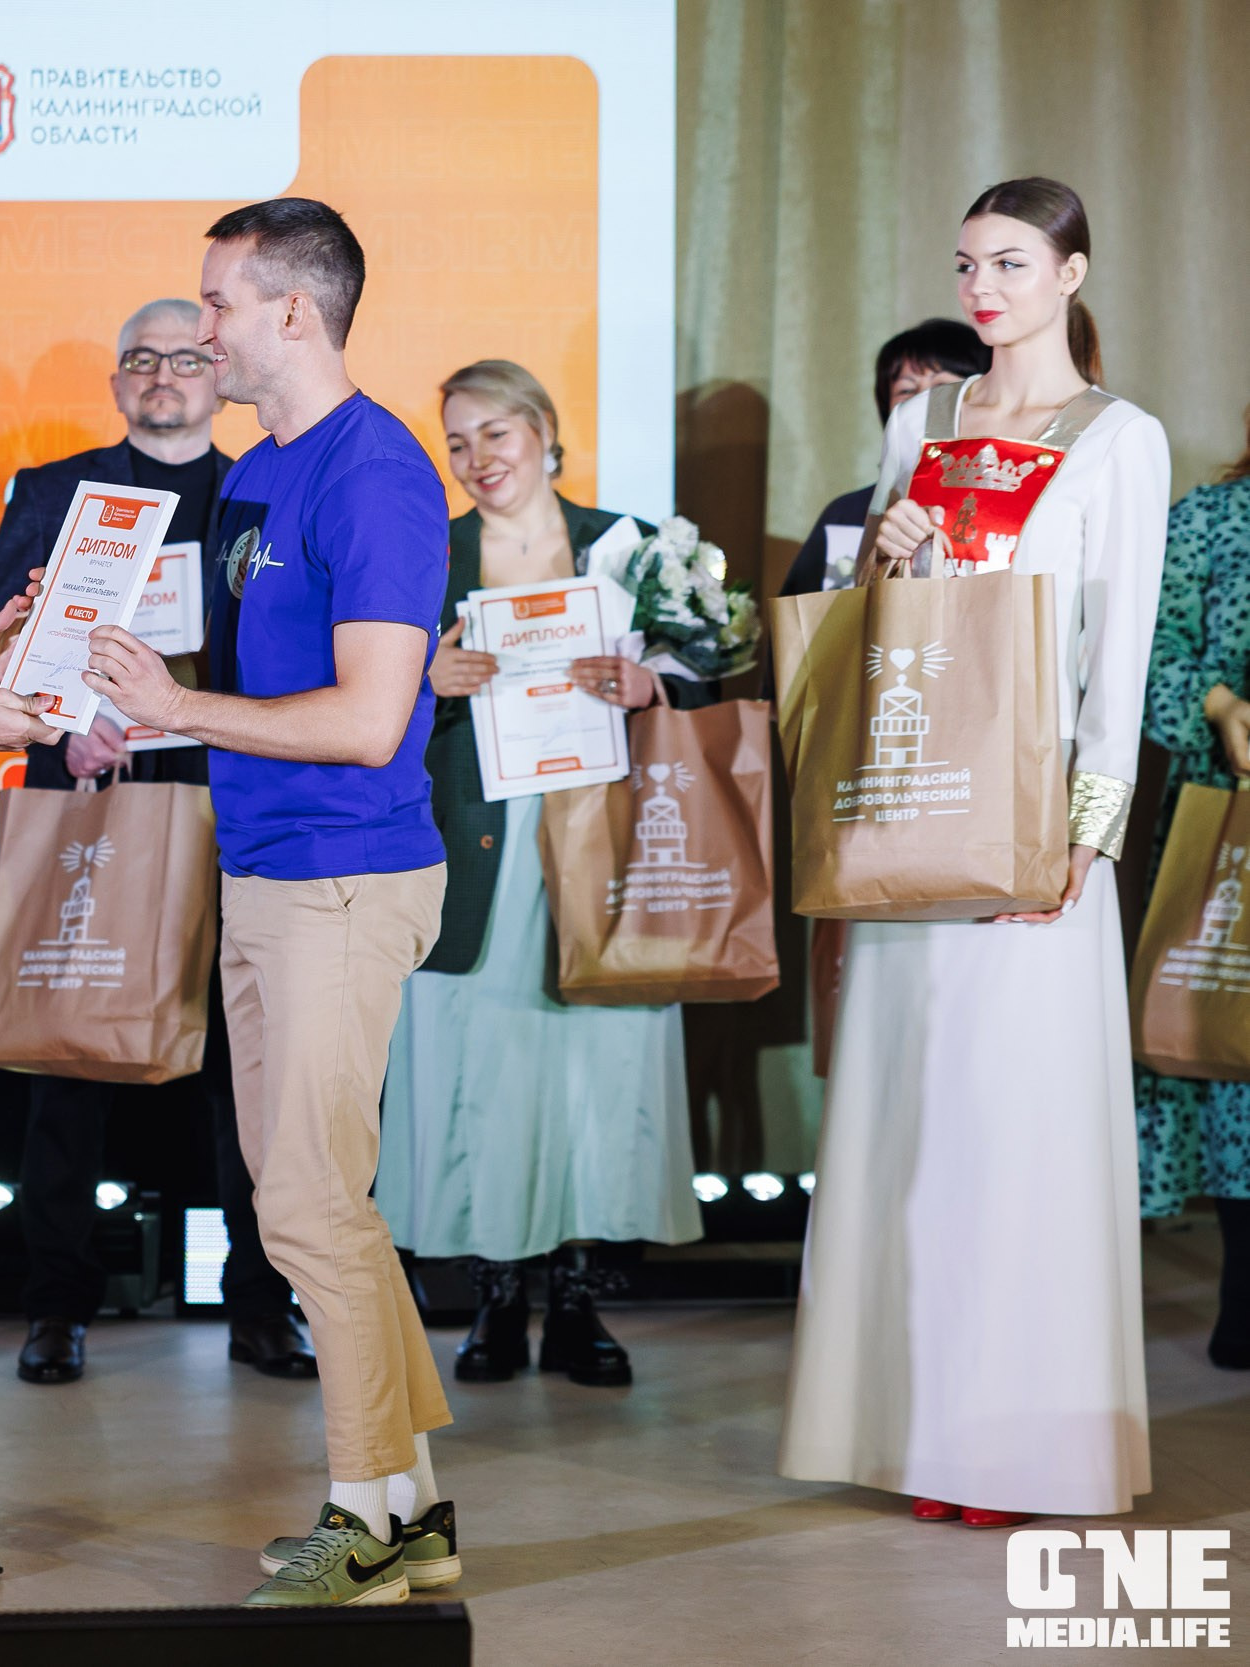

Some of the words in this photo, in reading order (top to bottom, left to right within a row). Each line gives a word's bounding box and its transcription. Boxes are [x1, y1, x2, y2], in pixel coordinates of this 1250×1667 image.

[30, 69, 221, 88] ПРАВИТЕЛЬСТВО
[30, 93, 262, 117] КАЛИНИНГРАДСКОЙ
[30, 126, 138, 145] ОБЛАСТИ
[75, 537, 138, 560] ДИПЛОМ
[62, 582, 86, 593] МИХАИЛУ
[85, 586, 120, 598] ВИТАЛЬЕВИЧУ
[82, 576, 107, 586] ГУТАРОВУ
[74, 610, 94, 620] МЕСТО
[501, 624, 586, 648] ДИПЛОМ
[836, 768, 970, 793] КАЛИНИНГРАДСКИЙ
[833, 786, 970, 810] ДОБРОВОЛЬЧЕСКИЙ
[875, 808, 919, 822] ЦЕНТР
